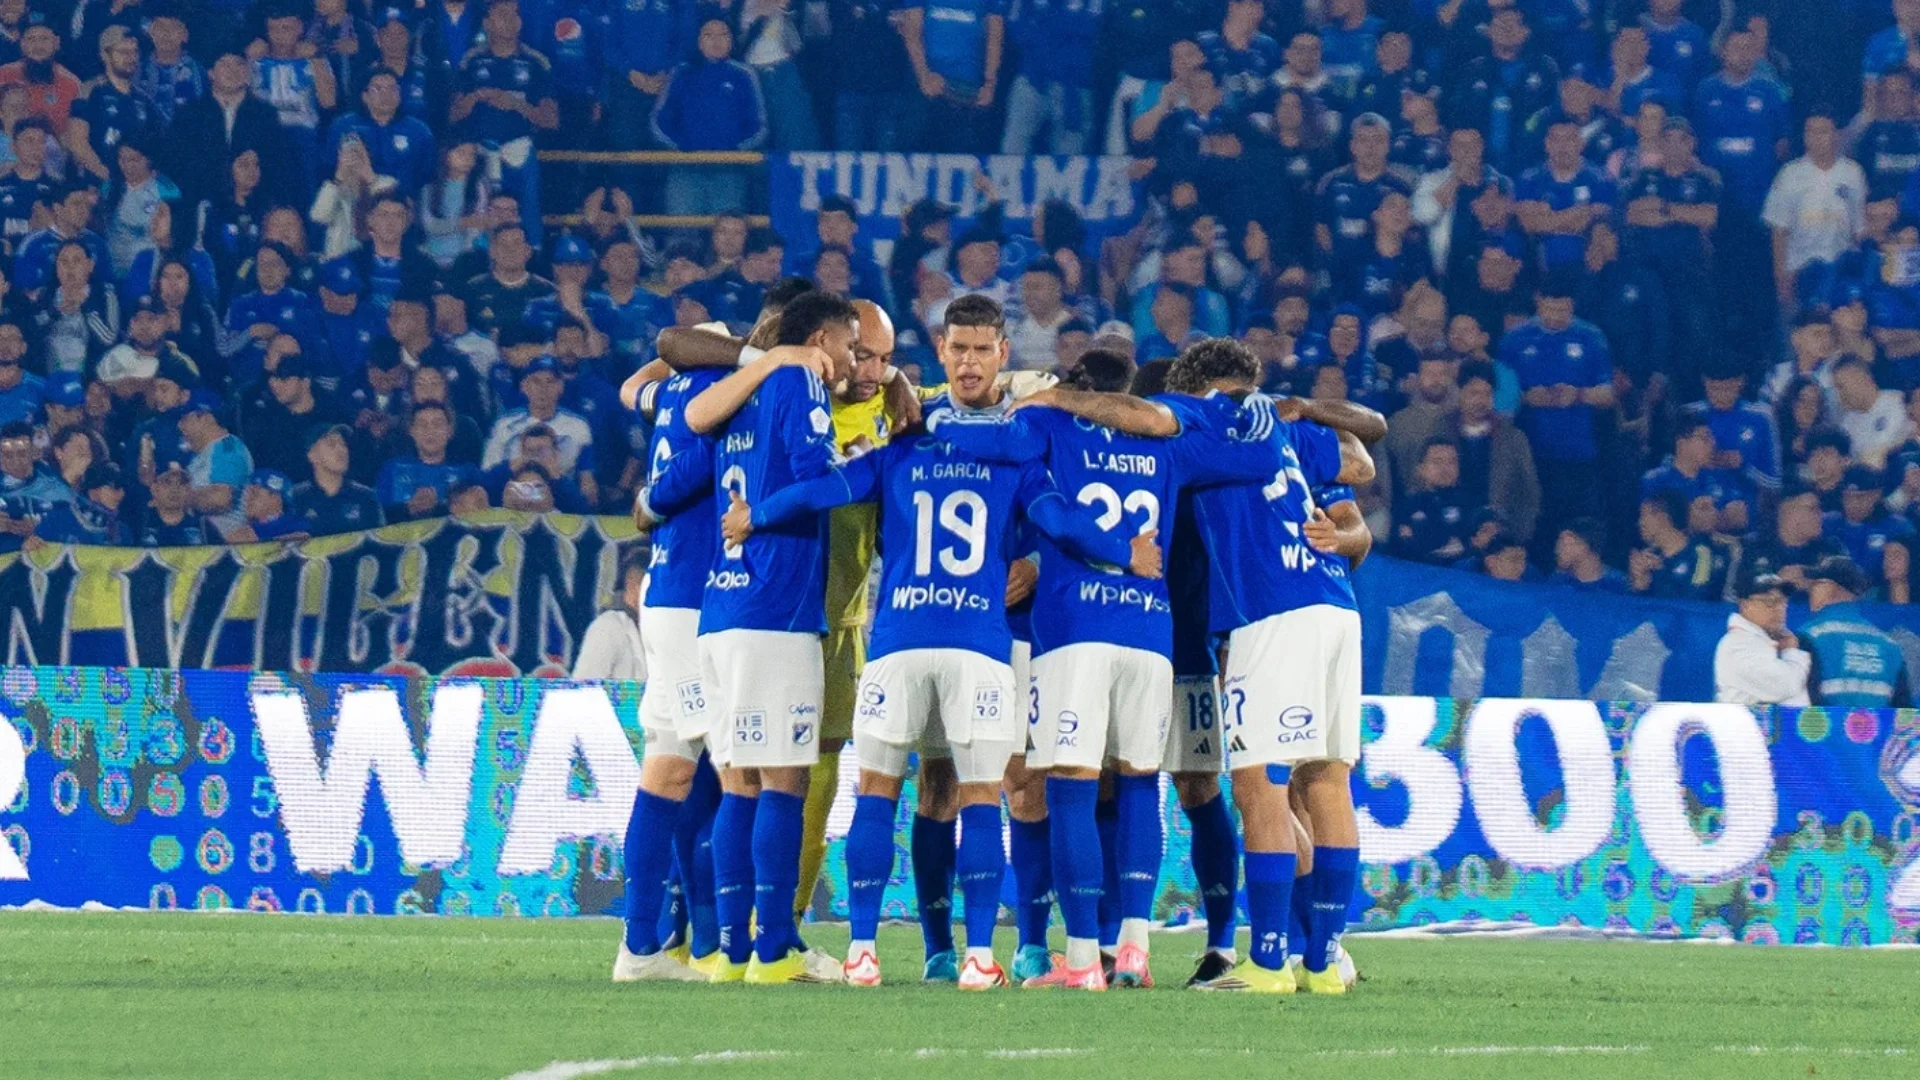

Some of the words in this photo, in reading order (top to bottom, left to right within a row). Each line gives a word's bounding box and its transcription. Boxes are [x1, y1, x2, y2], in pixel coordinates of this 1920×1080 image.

[789, 152, 1135, 220] TUNDAMA
[911, 466, 929, 482] M.
[913, 489, 988, 577] 19
[860, 705, 886, 720] GAC
[1187, 691, 1213, 732] 18
[1277, 730, 1319, 744] GAC
[1355, 694, 1778, 879] 300
